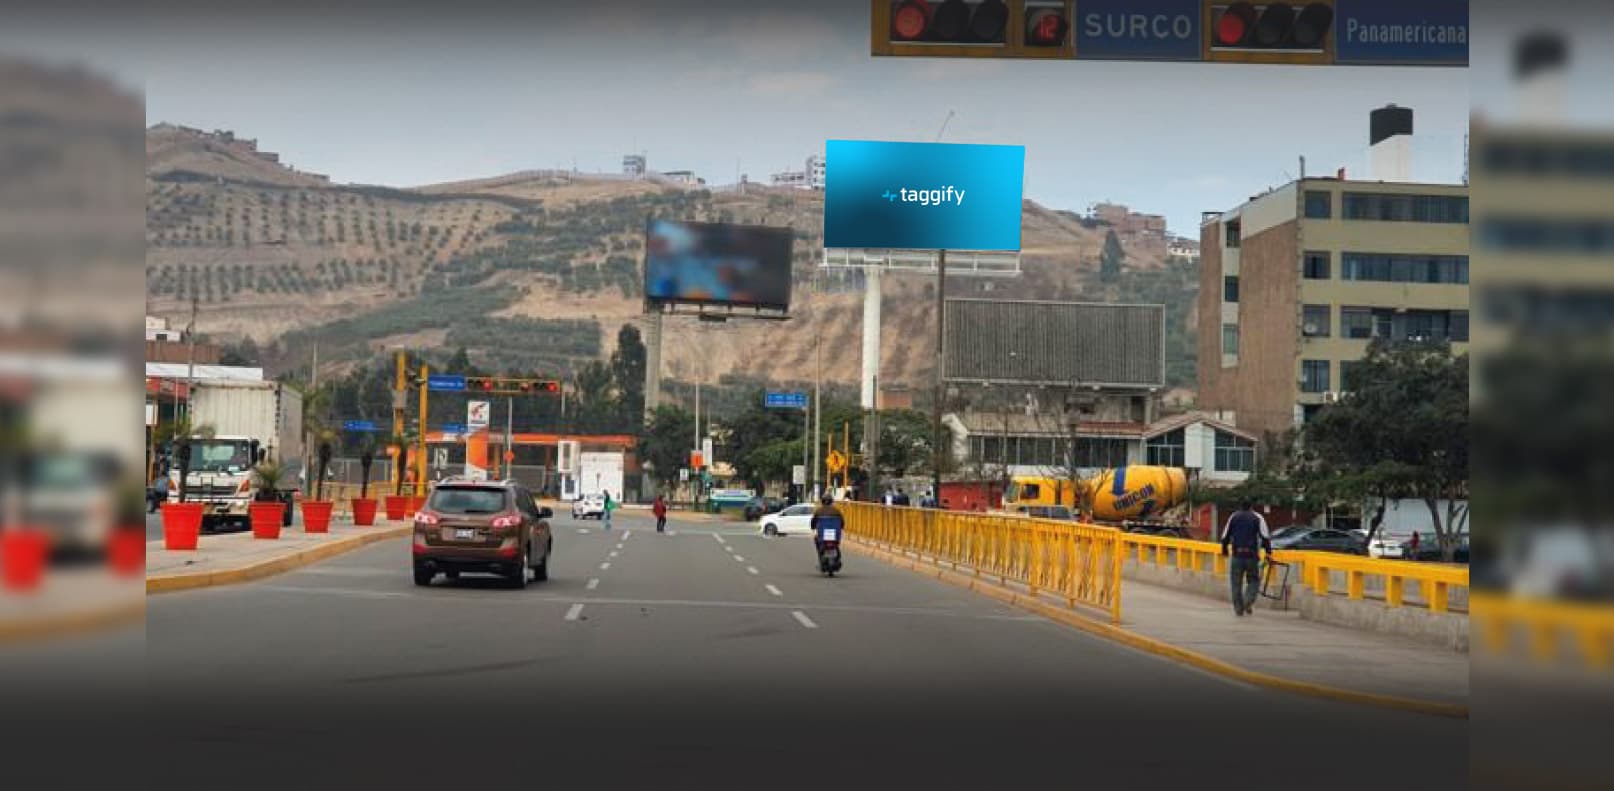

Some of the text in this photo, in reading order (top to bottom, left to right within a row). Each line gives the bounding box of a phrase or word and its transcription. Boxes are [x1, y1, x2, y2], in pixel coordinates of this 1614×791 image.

[1085, 13, 1192, 40] SURCO
[1346, 17, 1467, 43] Panamericana
[900, 186, 966, 206] taggify
